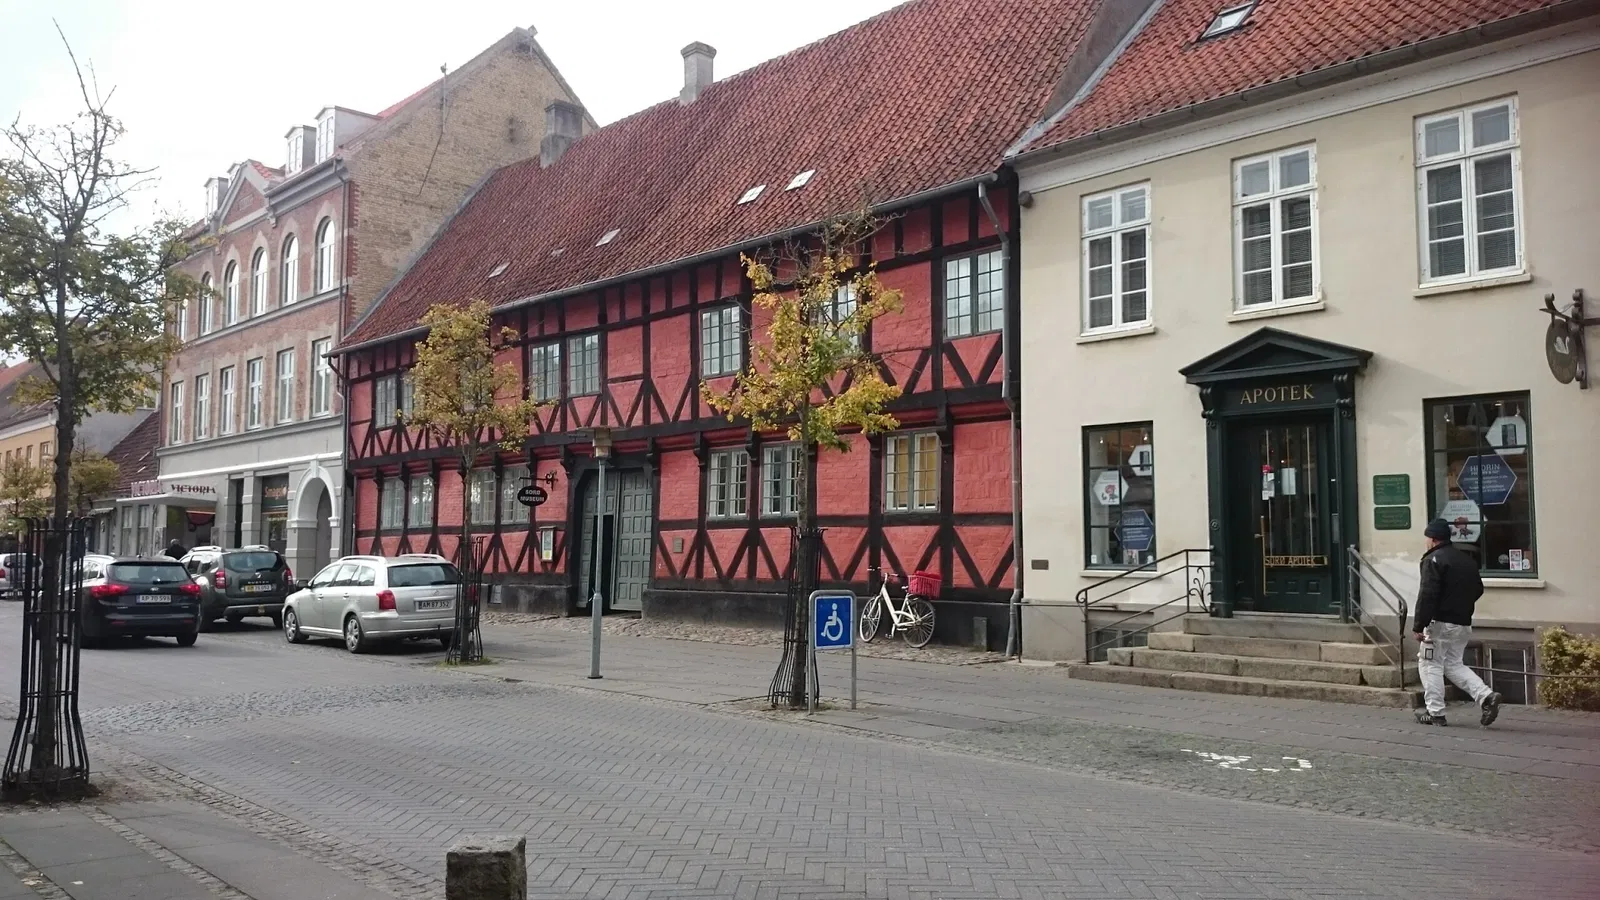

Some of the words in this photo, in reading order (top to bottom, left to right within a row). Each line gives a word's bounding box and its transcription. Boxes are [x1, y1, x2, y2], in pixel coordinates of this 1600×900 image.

[1240, 384, 1315, 405] APOTEK
[1470, 464, 1500, 472] HDRIN
[170, 484, 216, 494] VICTORIA
[1287, 556, 1315, 565] APOTEK
